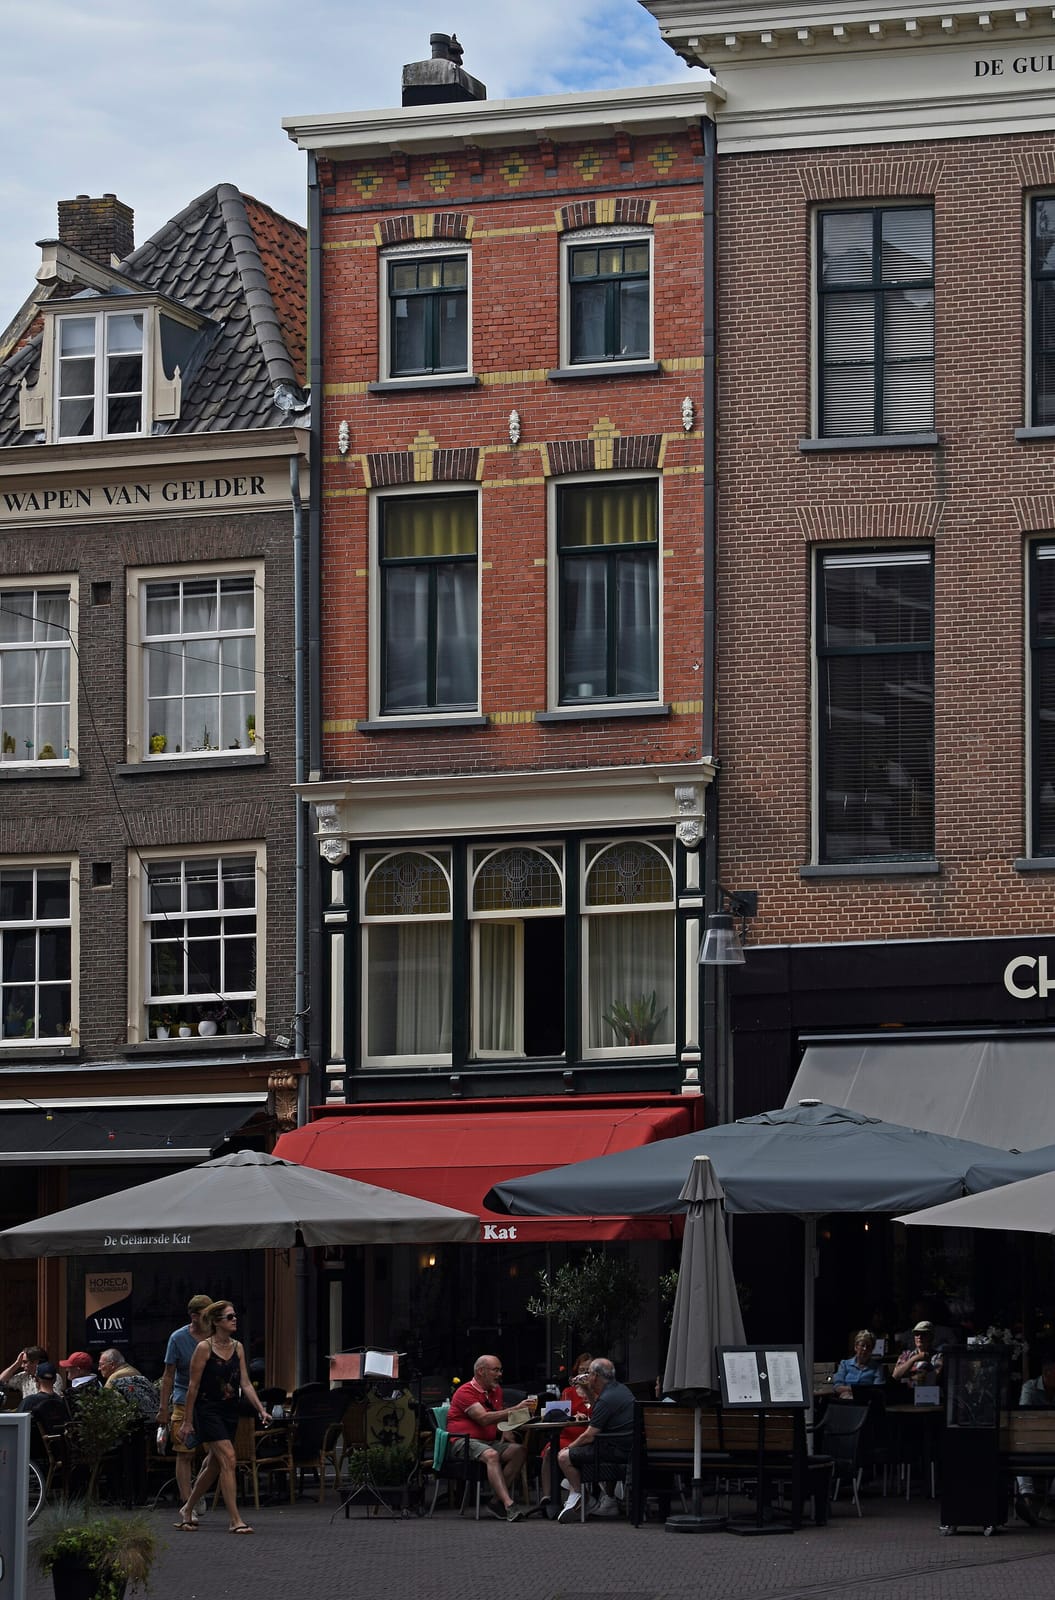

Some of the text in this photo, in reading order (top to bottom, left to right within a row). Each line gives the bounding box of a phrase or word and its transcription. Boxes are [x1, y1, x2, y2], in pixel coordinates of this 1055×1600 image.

[974, 59, 1004, 77] DE
[3, 475, 266, 512] WAPEN VAN GELDER
[103, 1232, 191, 1247] De Gelaarsde Kat
[483, 1224, 517, 1240] Kat
[89, 1277, 128, 1287] HORECA
[94, 1317, 125, 1330] VDW
